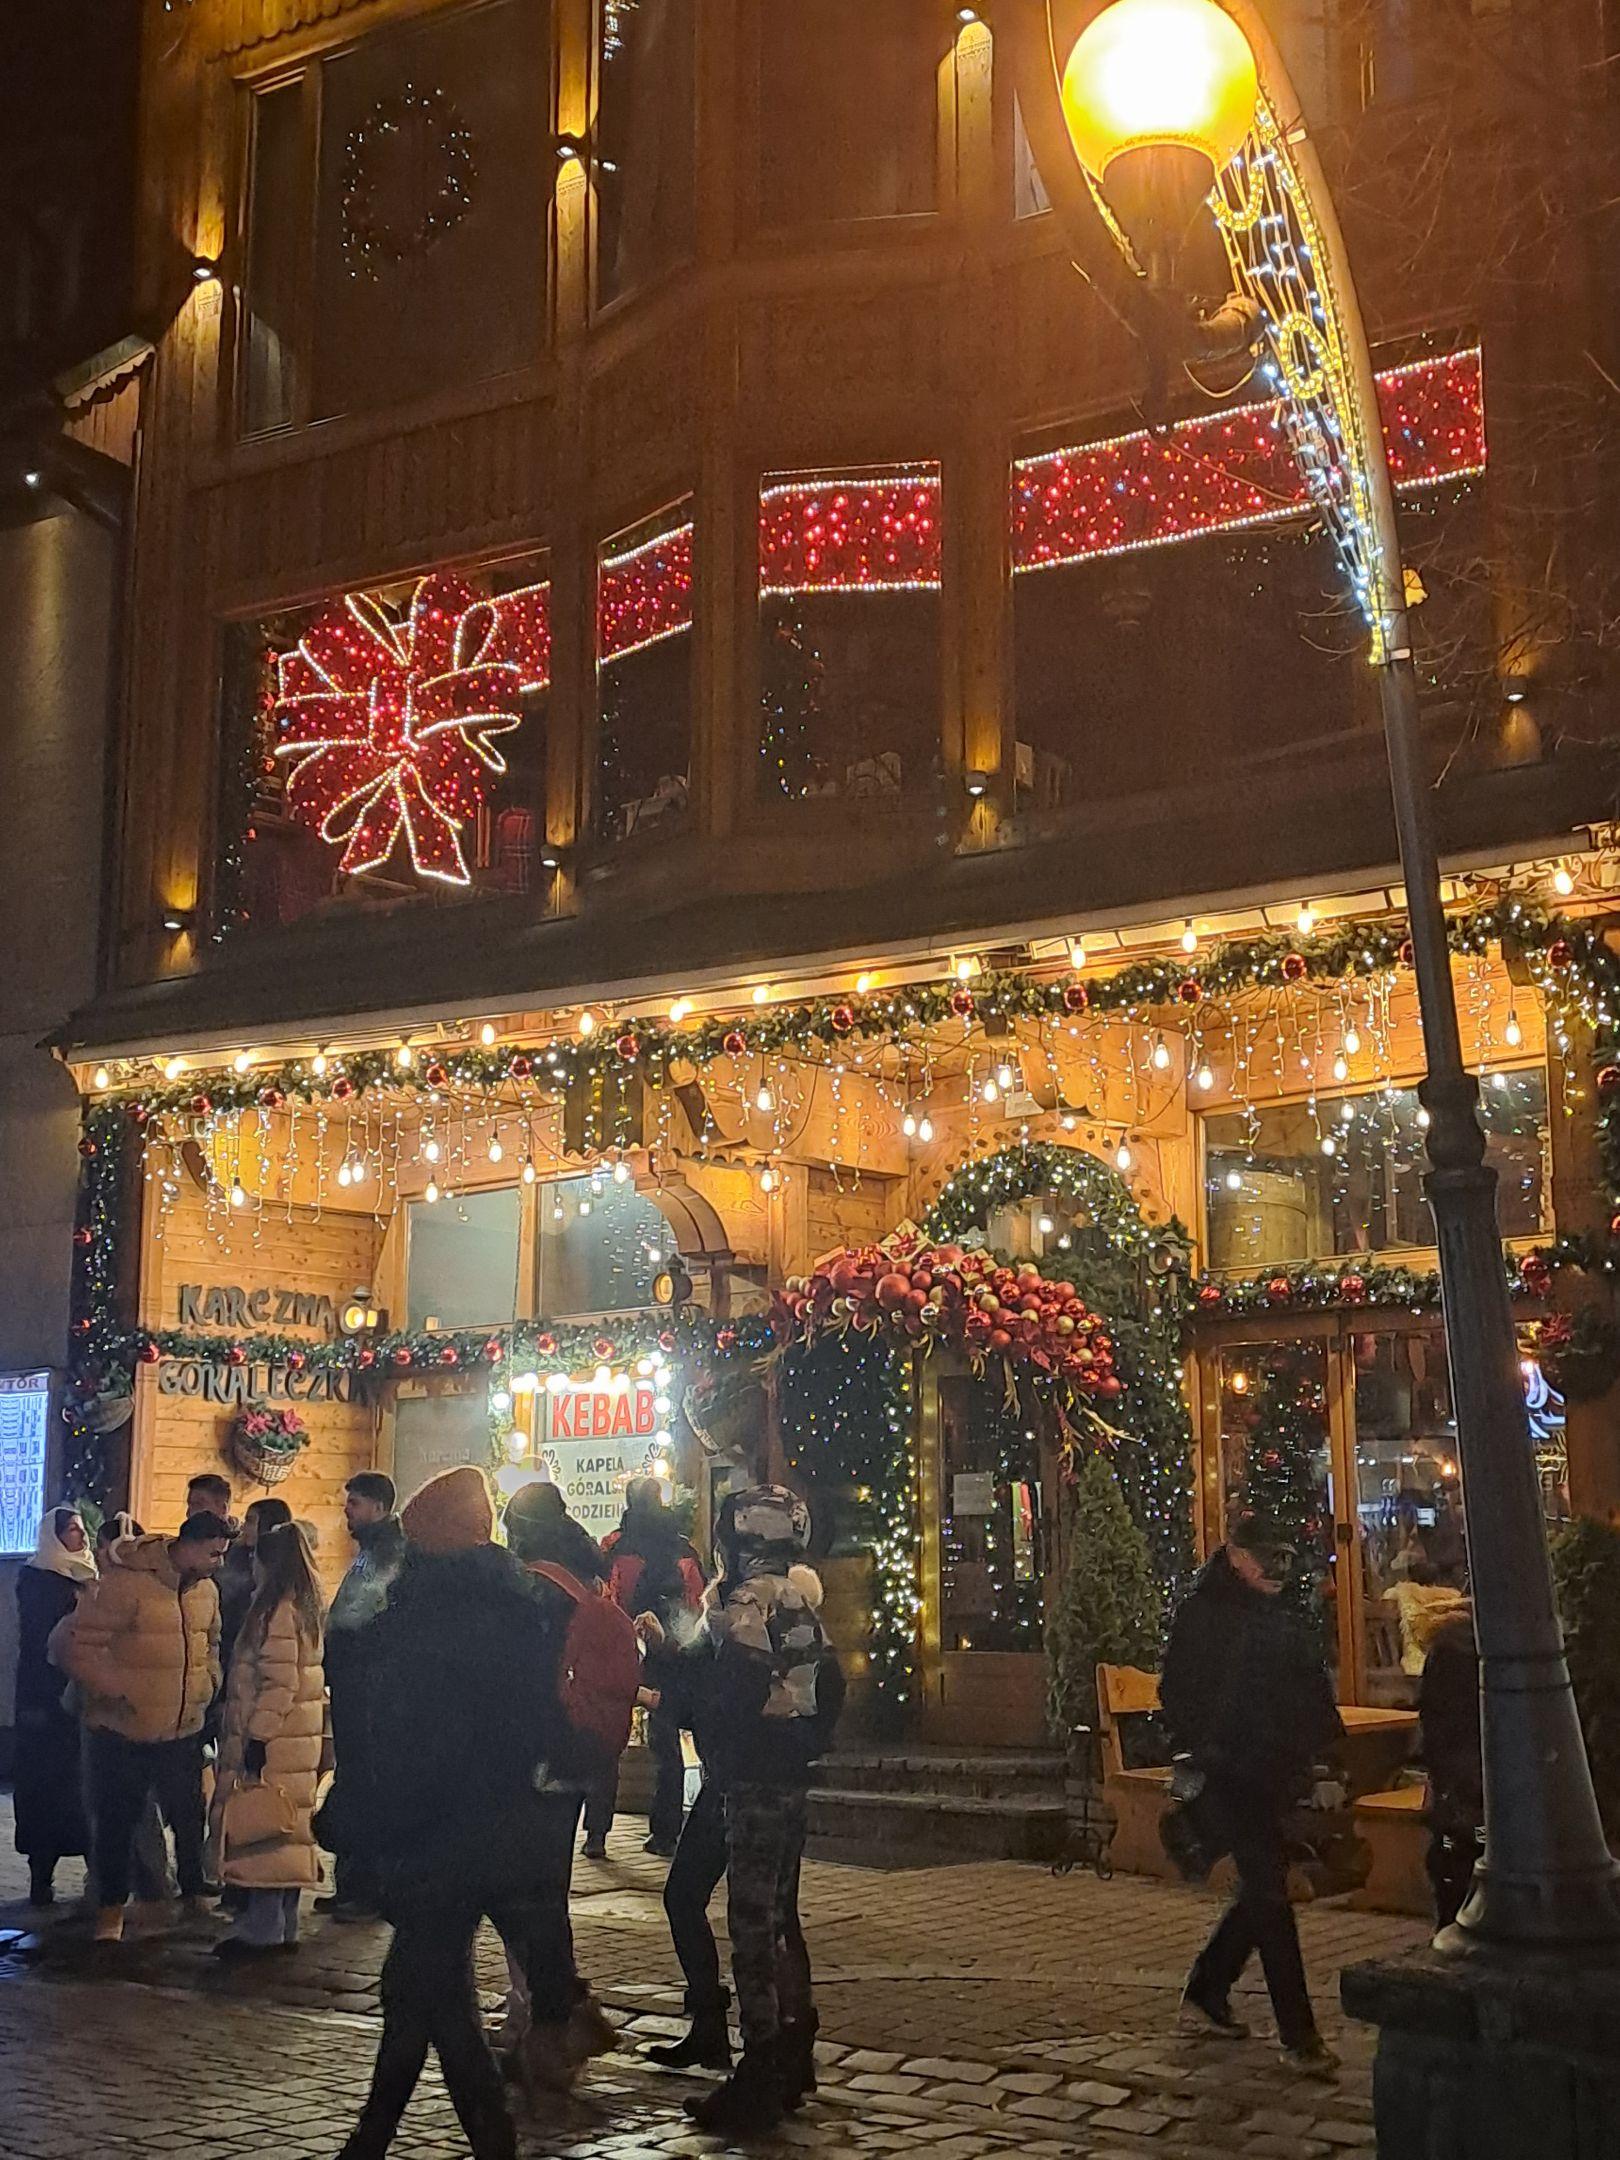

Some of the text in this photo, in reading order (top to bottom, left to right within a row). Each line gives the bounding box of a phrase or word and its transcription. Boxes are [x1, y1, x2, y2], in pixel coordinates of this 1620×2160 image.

[179, 1284, 336, 1334] KARCZMA
[552, 1389, 656, 1438] KEBAB
[576, 1456, 624, 1473] KAPELA
